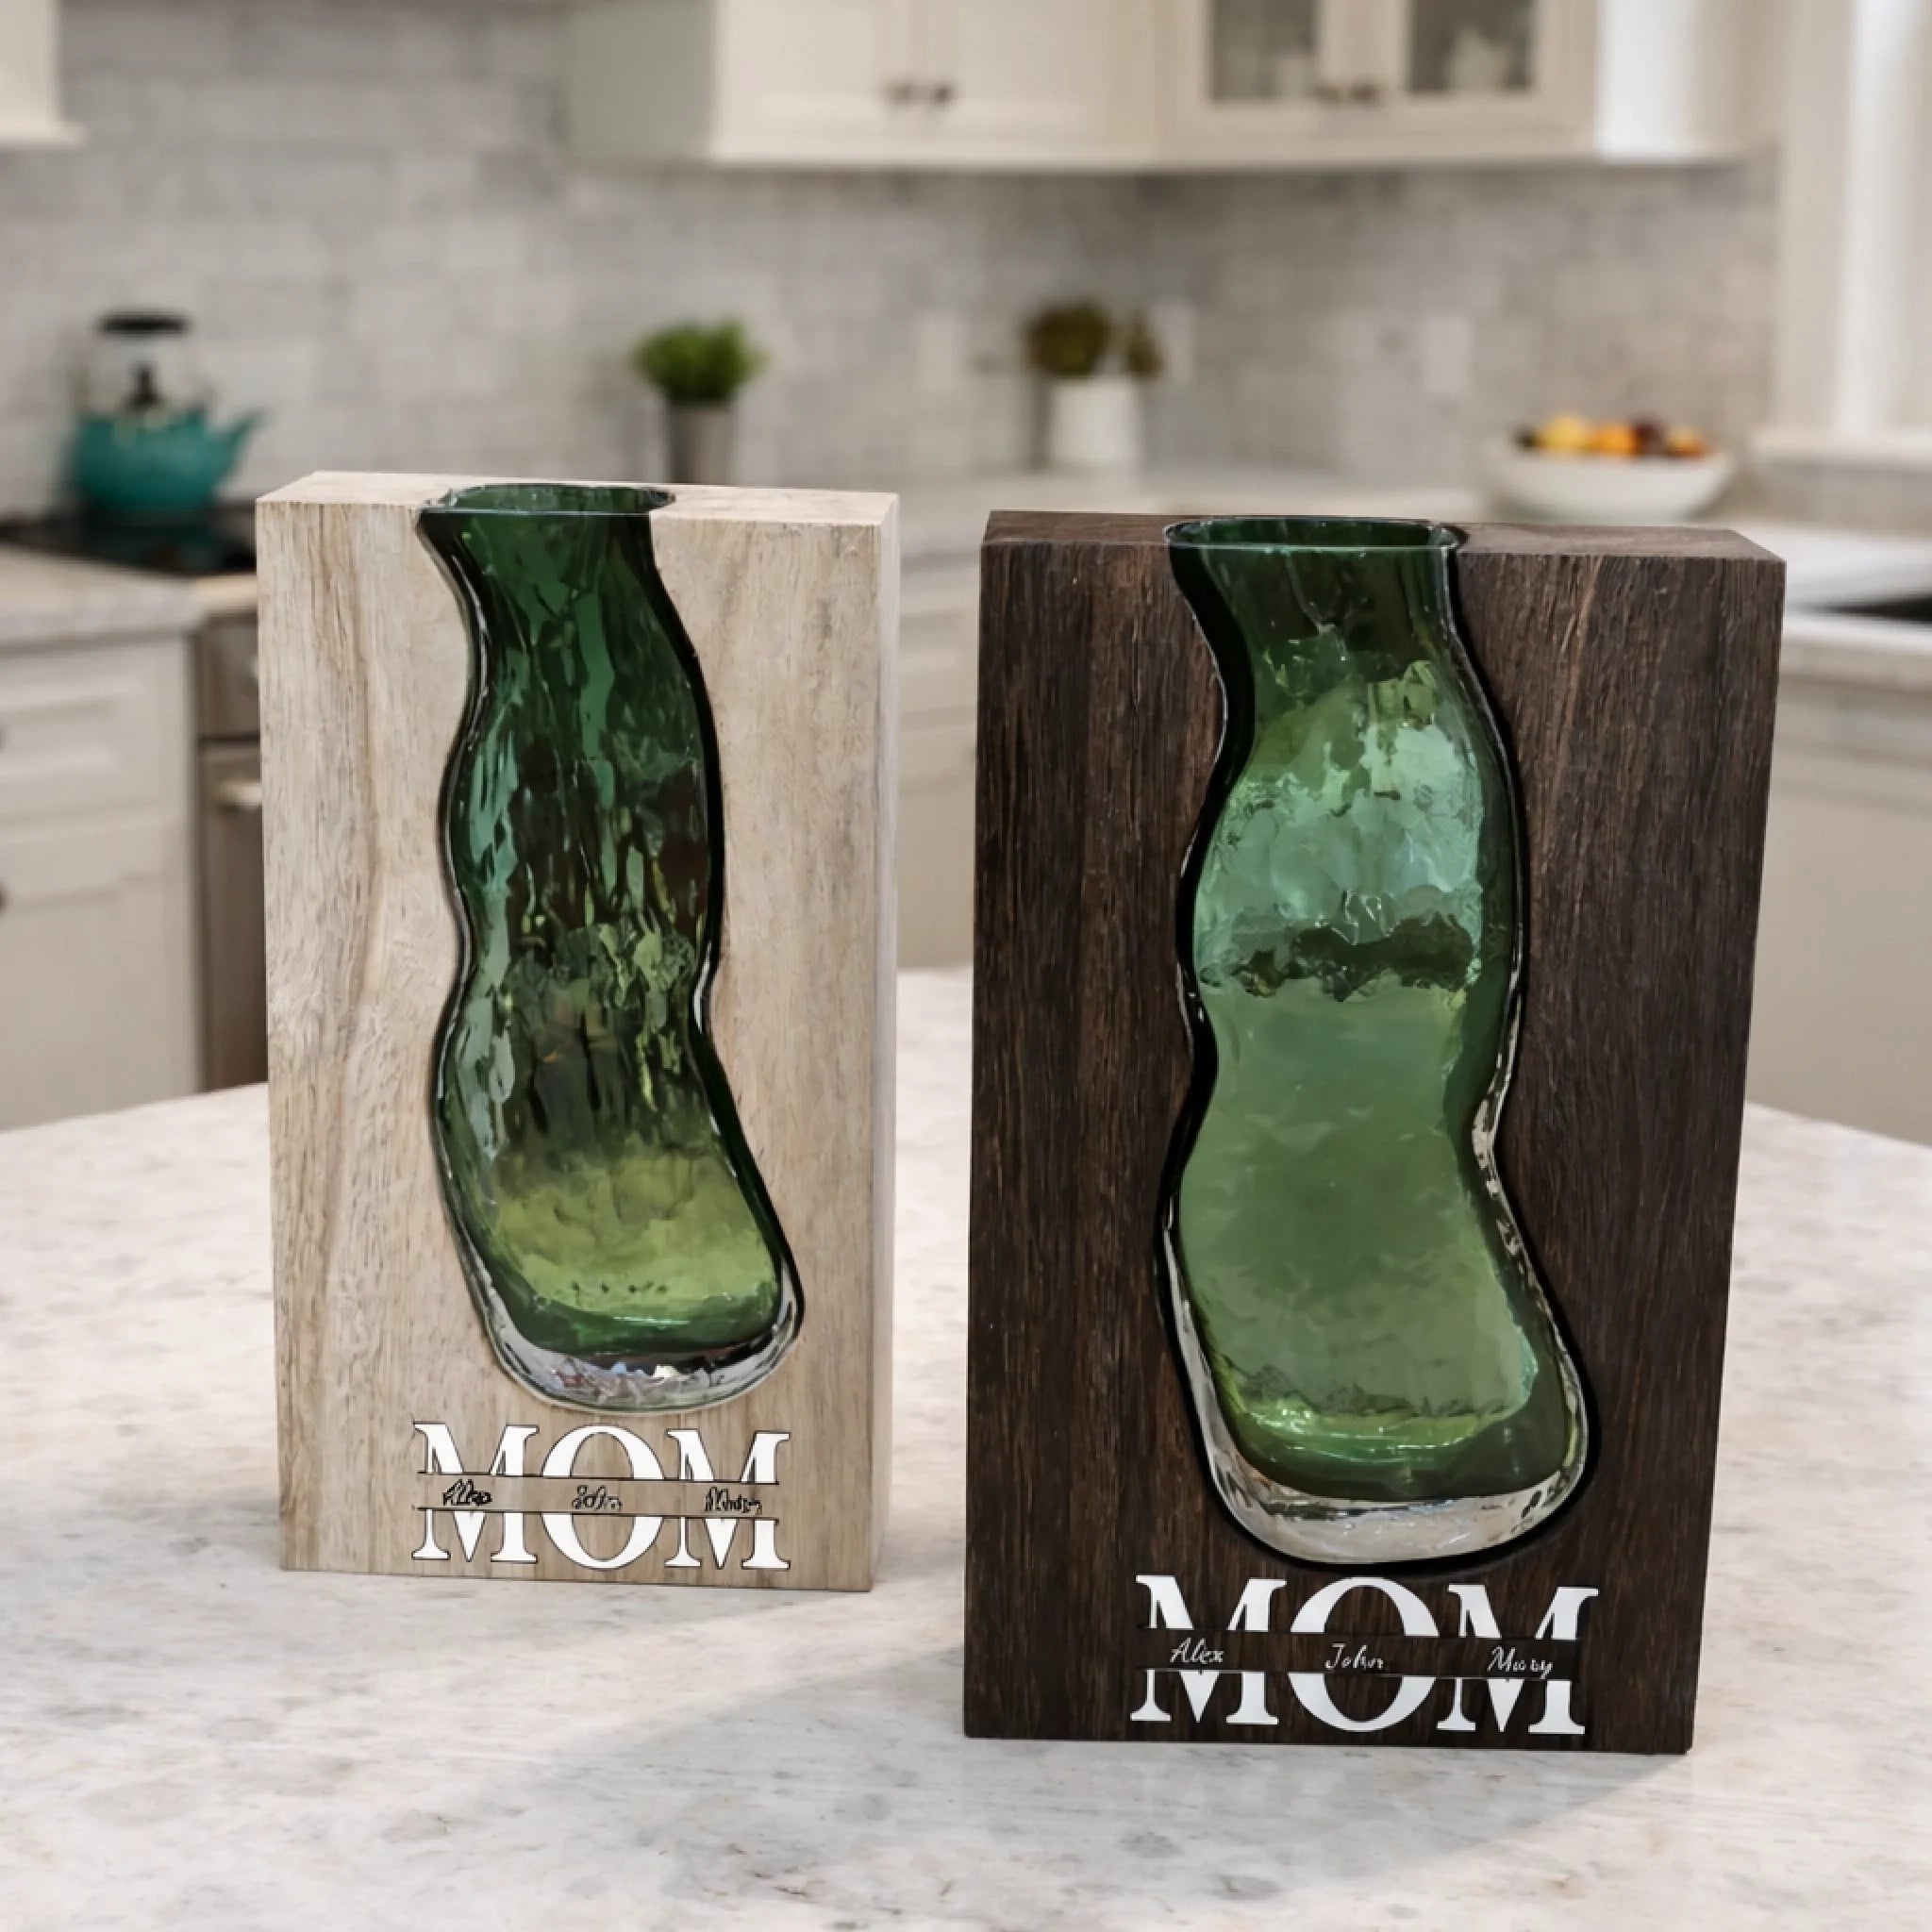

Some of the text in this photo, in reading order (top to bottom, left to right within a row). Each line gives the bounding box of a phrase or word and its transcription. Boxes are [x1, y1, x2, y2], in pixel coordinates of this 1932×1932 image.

[412, 1422, 791, 1570] MOM
[1130, 1574, 1598, 1735] MOM
[1170, 1637, 1224, 1665] Alex
